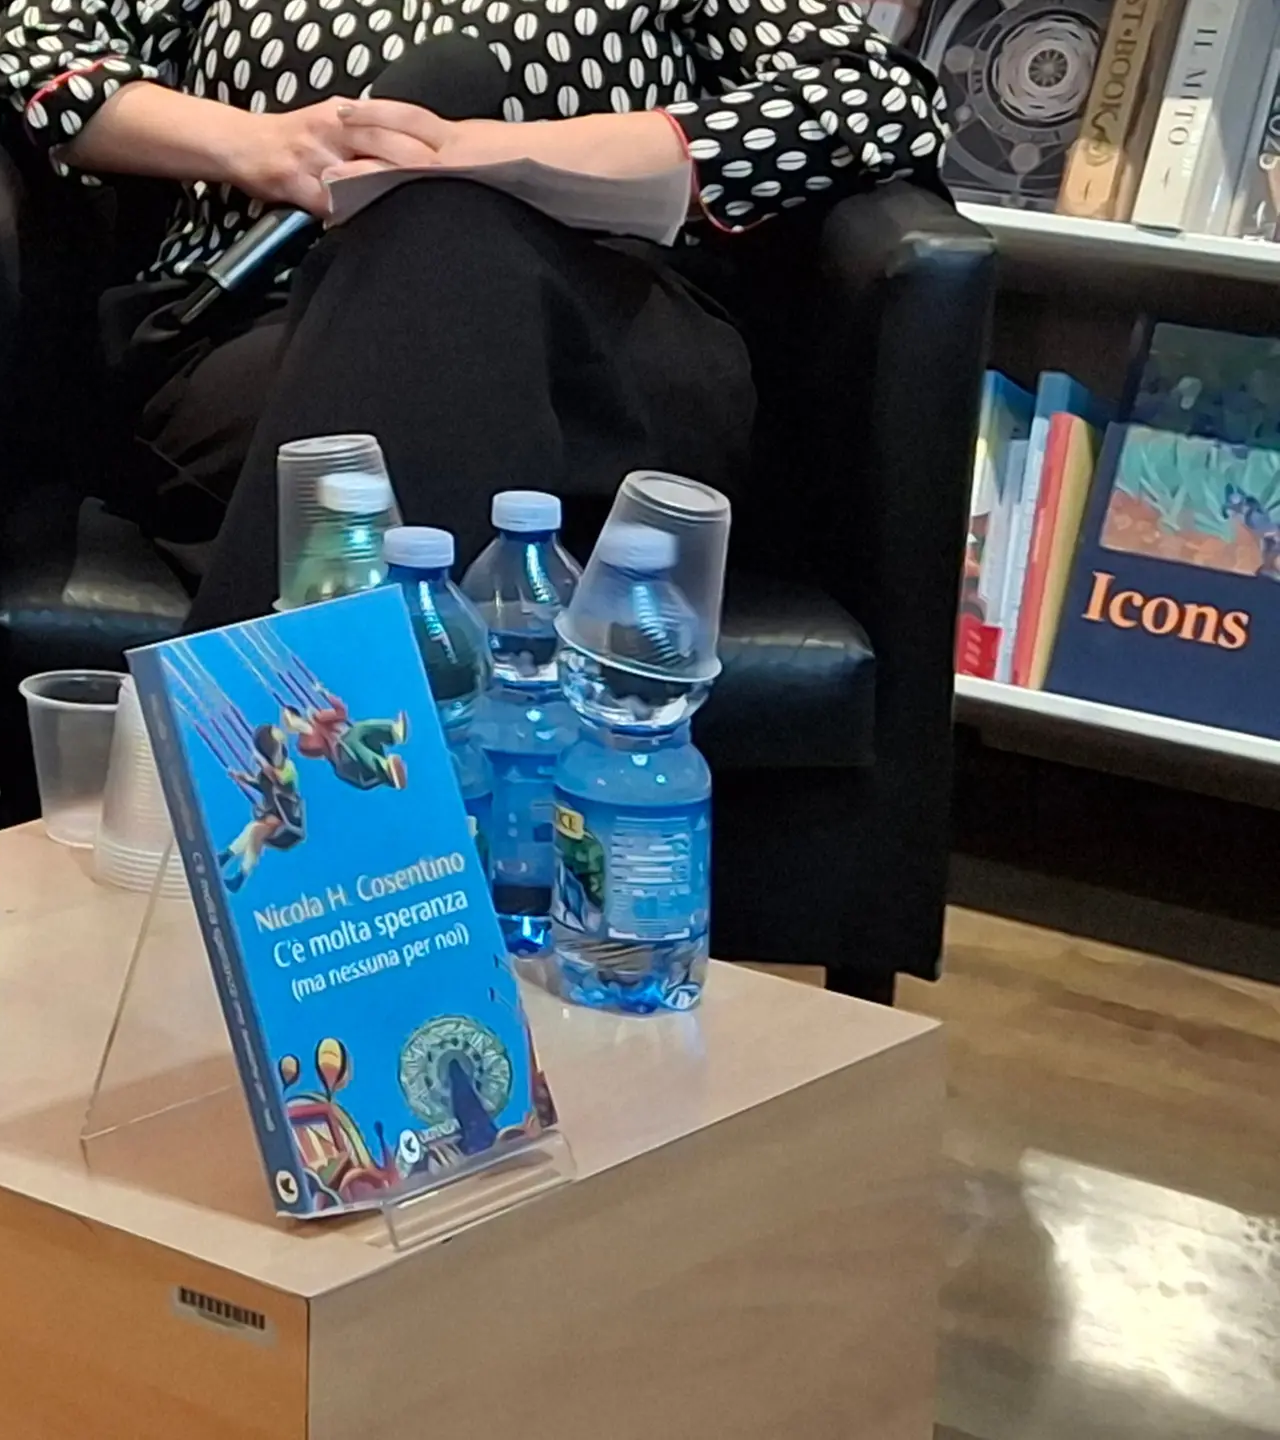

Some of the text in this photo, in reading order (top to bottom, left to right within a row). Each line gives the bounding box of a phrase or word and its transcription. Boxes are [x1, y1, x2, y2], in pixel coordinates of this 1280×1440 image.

[1192, 25, 1218, 50] IL
[1091, 33, 1138, 134] BOOK
[1166, 66, 1206, 148] MITO
[1081, 568, 1252, 651] Icons
[252, 850, 466, 934] Nicola H. Cosentino
[273, 889, 469, 968] C'è molta speranza
[291, 921, 471, 1004] (ma nessuna per noi)
